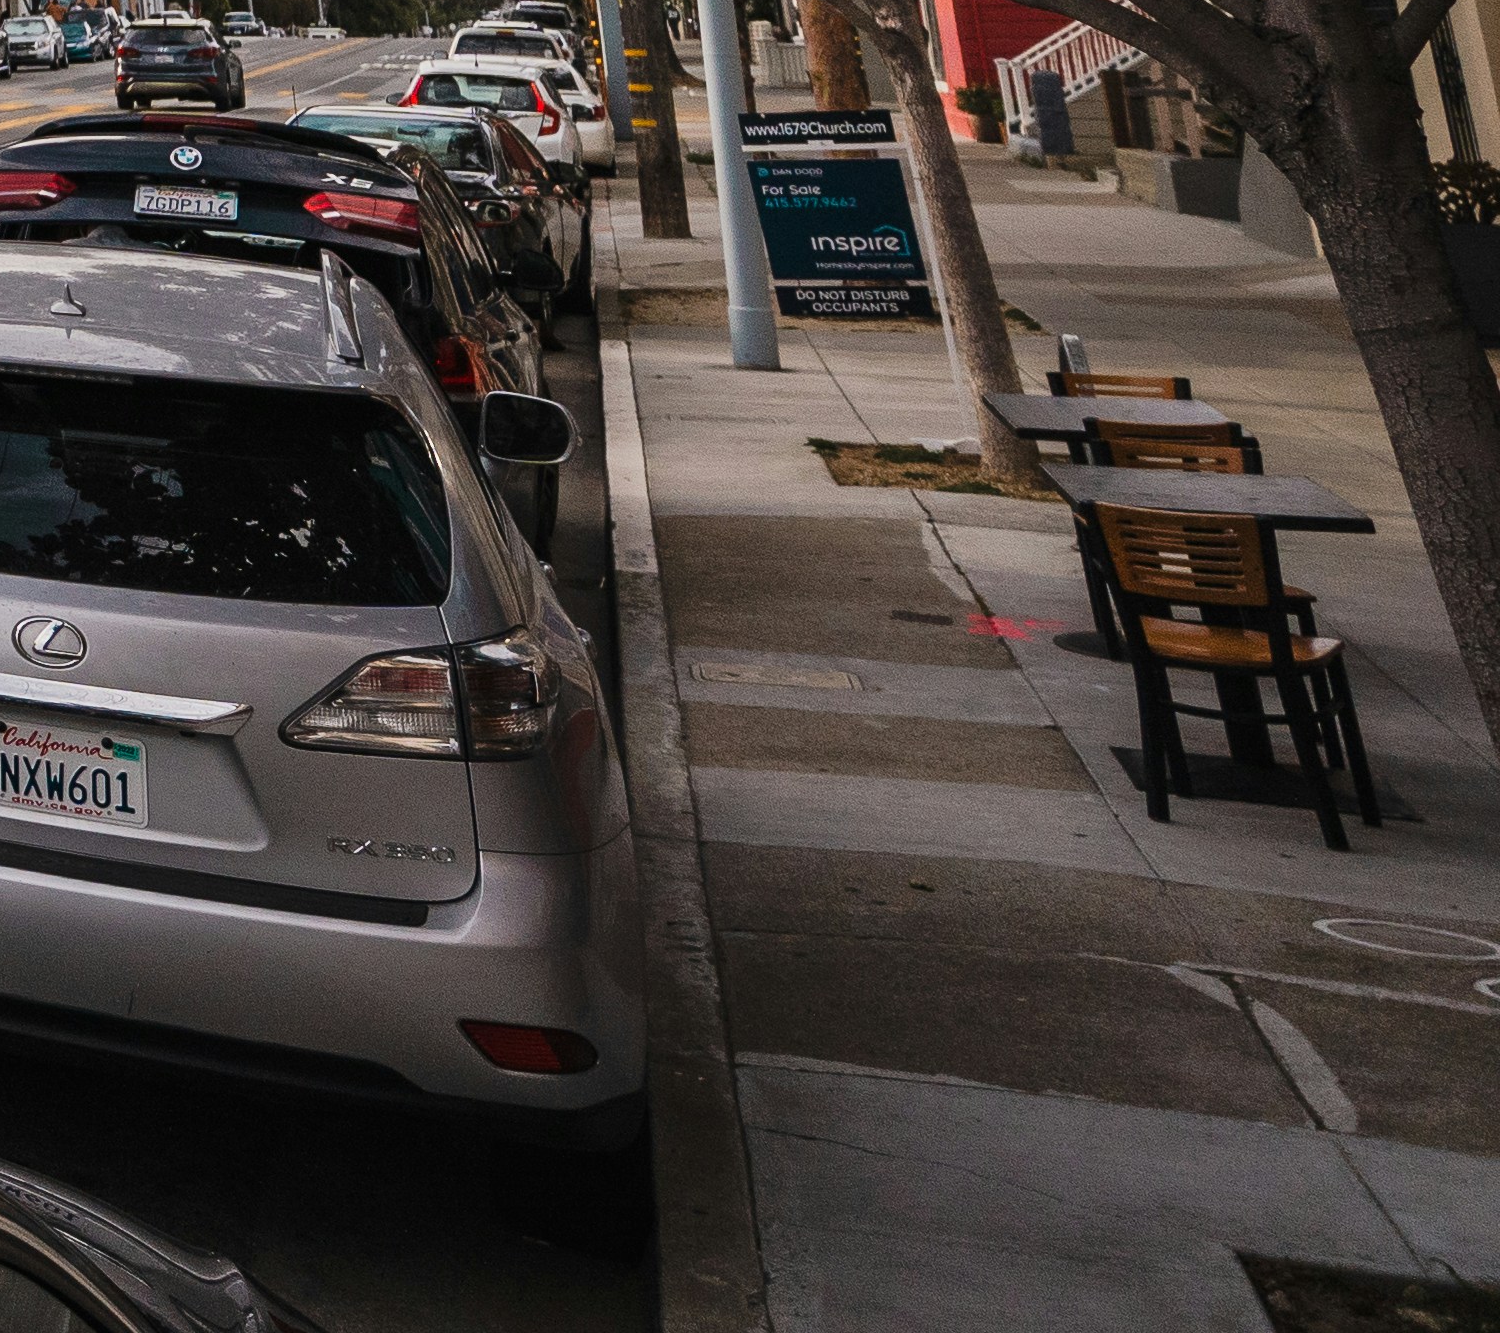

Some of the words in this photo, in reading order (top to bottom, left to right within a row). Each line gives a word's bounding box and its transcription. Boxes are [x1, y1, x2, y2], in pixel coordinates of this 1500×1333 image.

[744, 120, 887, 137] www.1679Church.com
[761, 184, 784, 196] For
[789, 184, 821, 196] Sale
[143, 195, 231, 214] 7GDP116
[810, 235, 900, 257] inspire
[795, 290, 816, 300] DO
[818, 290, 847, 300] NOT
[851, 290, 910, 301] DISTURB
[812, 301, 900, 313] OCCUPANTS
[2, 726, 114, 760] California
[11, 796, 104, 817] dmv.ca.gov
[326, 835, 380, 858] RX
[381, 840, 458, 864] 350
